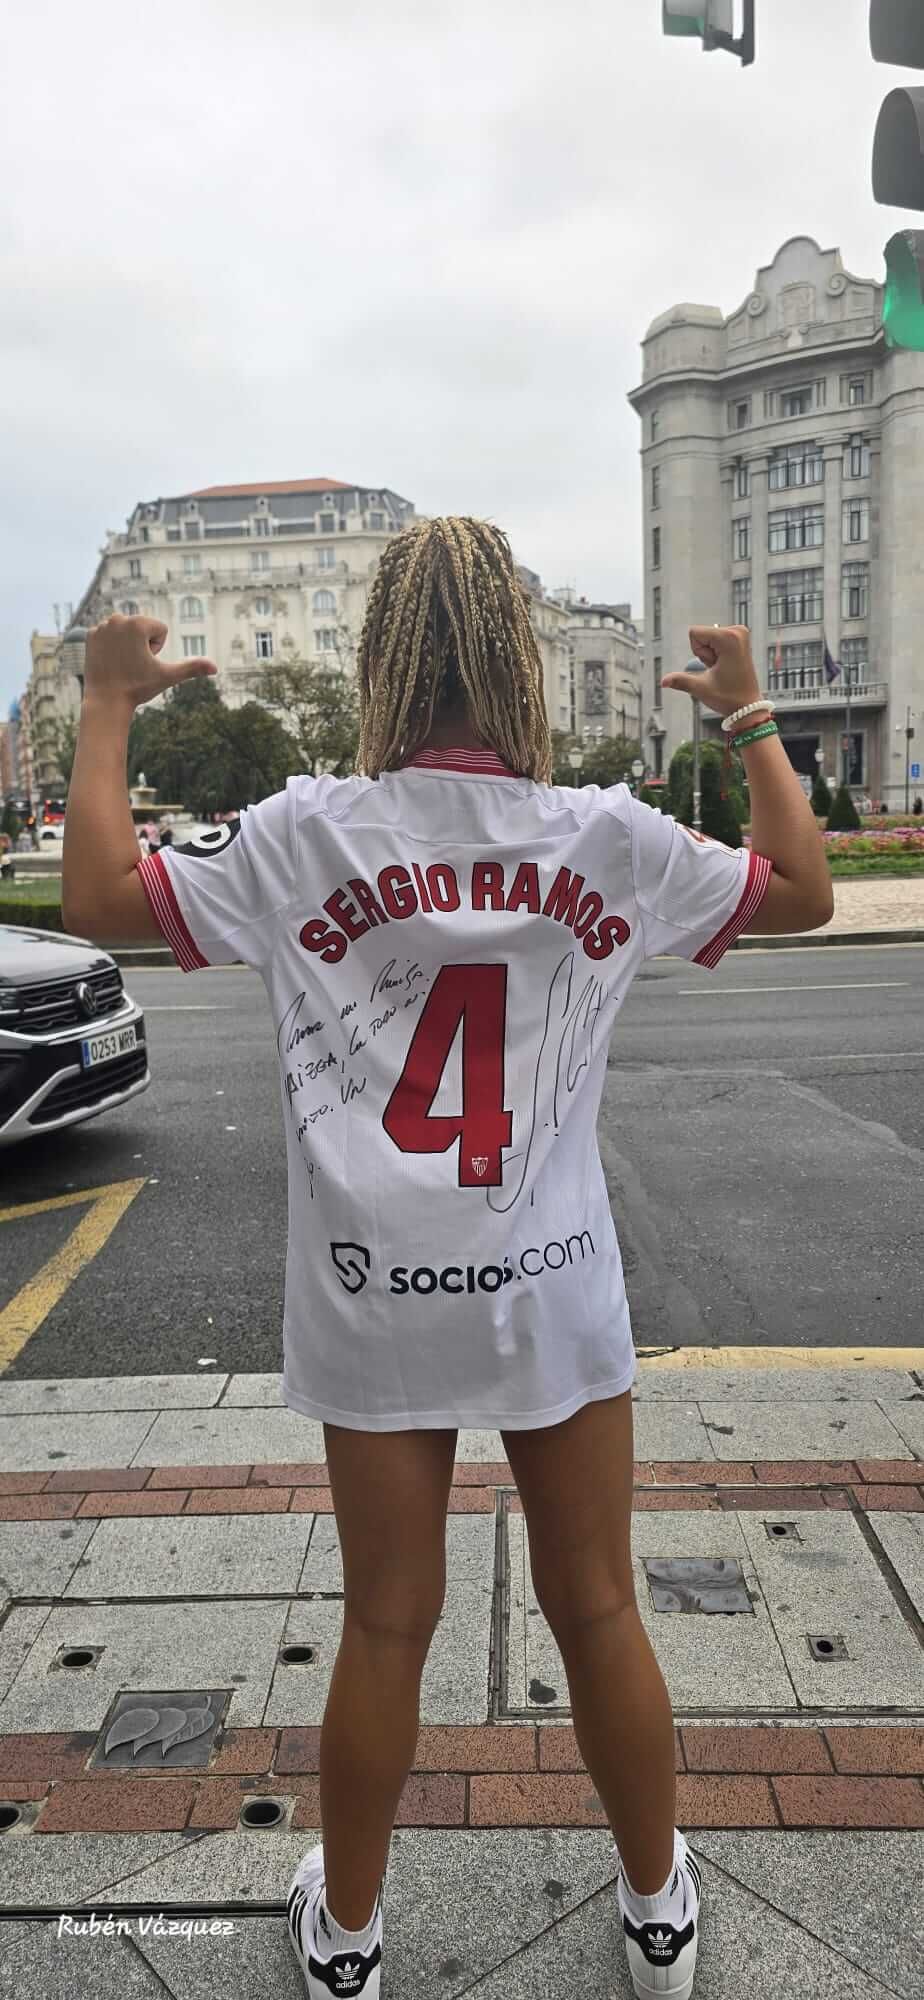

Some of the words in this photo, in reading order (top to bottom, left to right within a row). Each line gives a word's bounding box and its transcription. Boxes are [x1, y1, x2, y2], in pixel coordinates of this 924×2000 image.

[300, 862, 461, 964] SERGIO
[471, 861, 631, 961] RAMOS
[91, 1036, 117, 1061] 0253
[382, 963, 513, 1187] 4
[649, 1948, 673, 1956] adidas
[335, 1979, 361, 1989] adidas
